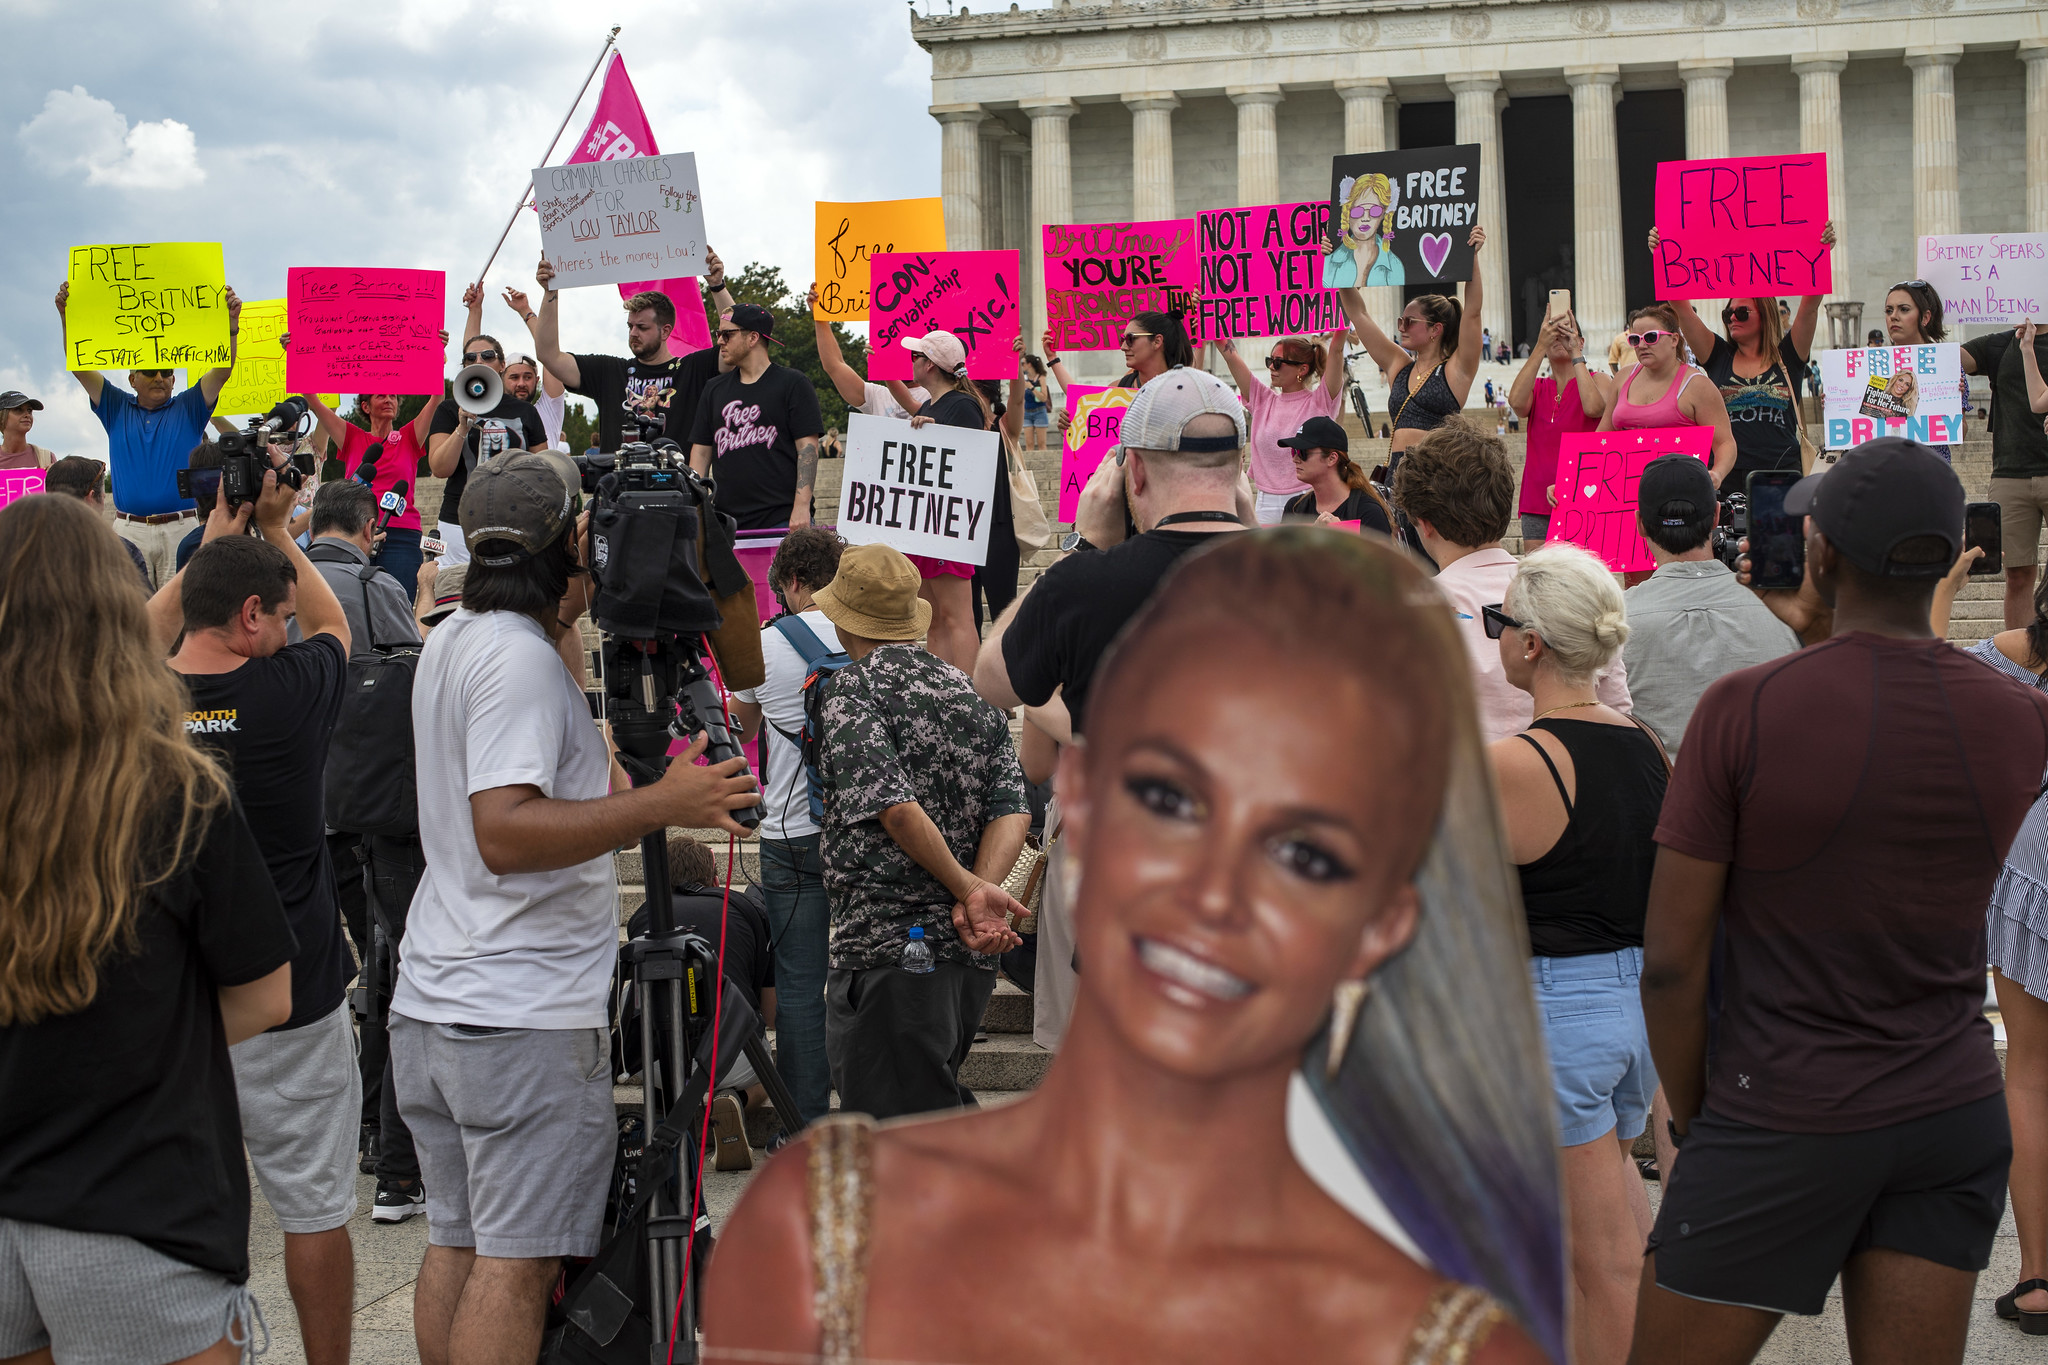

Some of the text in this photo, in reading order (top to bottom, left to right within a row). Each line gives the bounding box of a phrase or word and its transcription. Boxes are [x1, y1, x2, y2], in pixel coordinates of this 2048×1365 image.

[587, 120, 646, 161] #FR
[551, 157, 672, 191] CRIMINAL CHARGES
[1406, 166, 1467, 199] FREE
[594, 189, 626, 212] FOR
[659, 184, 698, 203] Follow the
[1680, 161, 1813, 230] FREE
[543, 216, 562, 232] Sports
[570, 210, 661, 239] LOU TAYLOR
[1200, 210, 1252, 253] NOT
[1261, 208, 1285, 249] A
[1396, 202, 1477, 230] BRITNEY
[600, 250, 621, 267] the
[666, 240, 697, 260] Lou?
[1926, 235, 2045, 262] BRITNEY SPEARS
[73, 245, 155, 282] FREE
[1062, 254, 1167, 287] YOU'RE
[1200, 249, 1318, 296] NOT YET
[1660, 239, 1825, 290] BRITNEY
[1960, 264, 2000, 281] IS A
[109, 284, 226, 311] BRITNEY
[348, 273, 411, 297] Britney
[875, 255, 937, 313] CON-
[1047, 287, 1164, 320] STRONGER
[1200, 290, 1350, 339] FREE WOMAN
[1944, 286, 2040, 314] UMAN BEING
[115, 311, 175, 335] STOP
[378, 323, 406, 335] STOP
[74, 335, 231, 366] ESTATE TRAFFICKING
[1846, 346, 1937, 378] FREE
[1866, 385, 1893, 402] Fighting
[1867, 395, 1878, 405] for
[1877, 398, 1890, 408] Her
[1889, 401, 1910, 414] Future
[721, 400, 761, 428] Free
[1088, 414, 1119, 438] BR
[1729, 406, 1785, 424] LOHA
[714, 421, 778, 459] Britney
[1828, 413, 1963, 447] BRITNEY
[880, 440, 957, 490] FREE
[1573, 450, 1683, 503] FRE
[847, 481, 985, 541] BRITNEY
[183, 709, 237, 721] SOUTH
[183, 718, 239, 734] PARK
